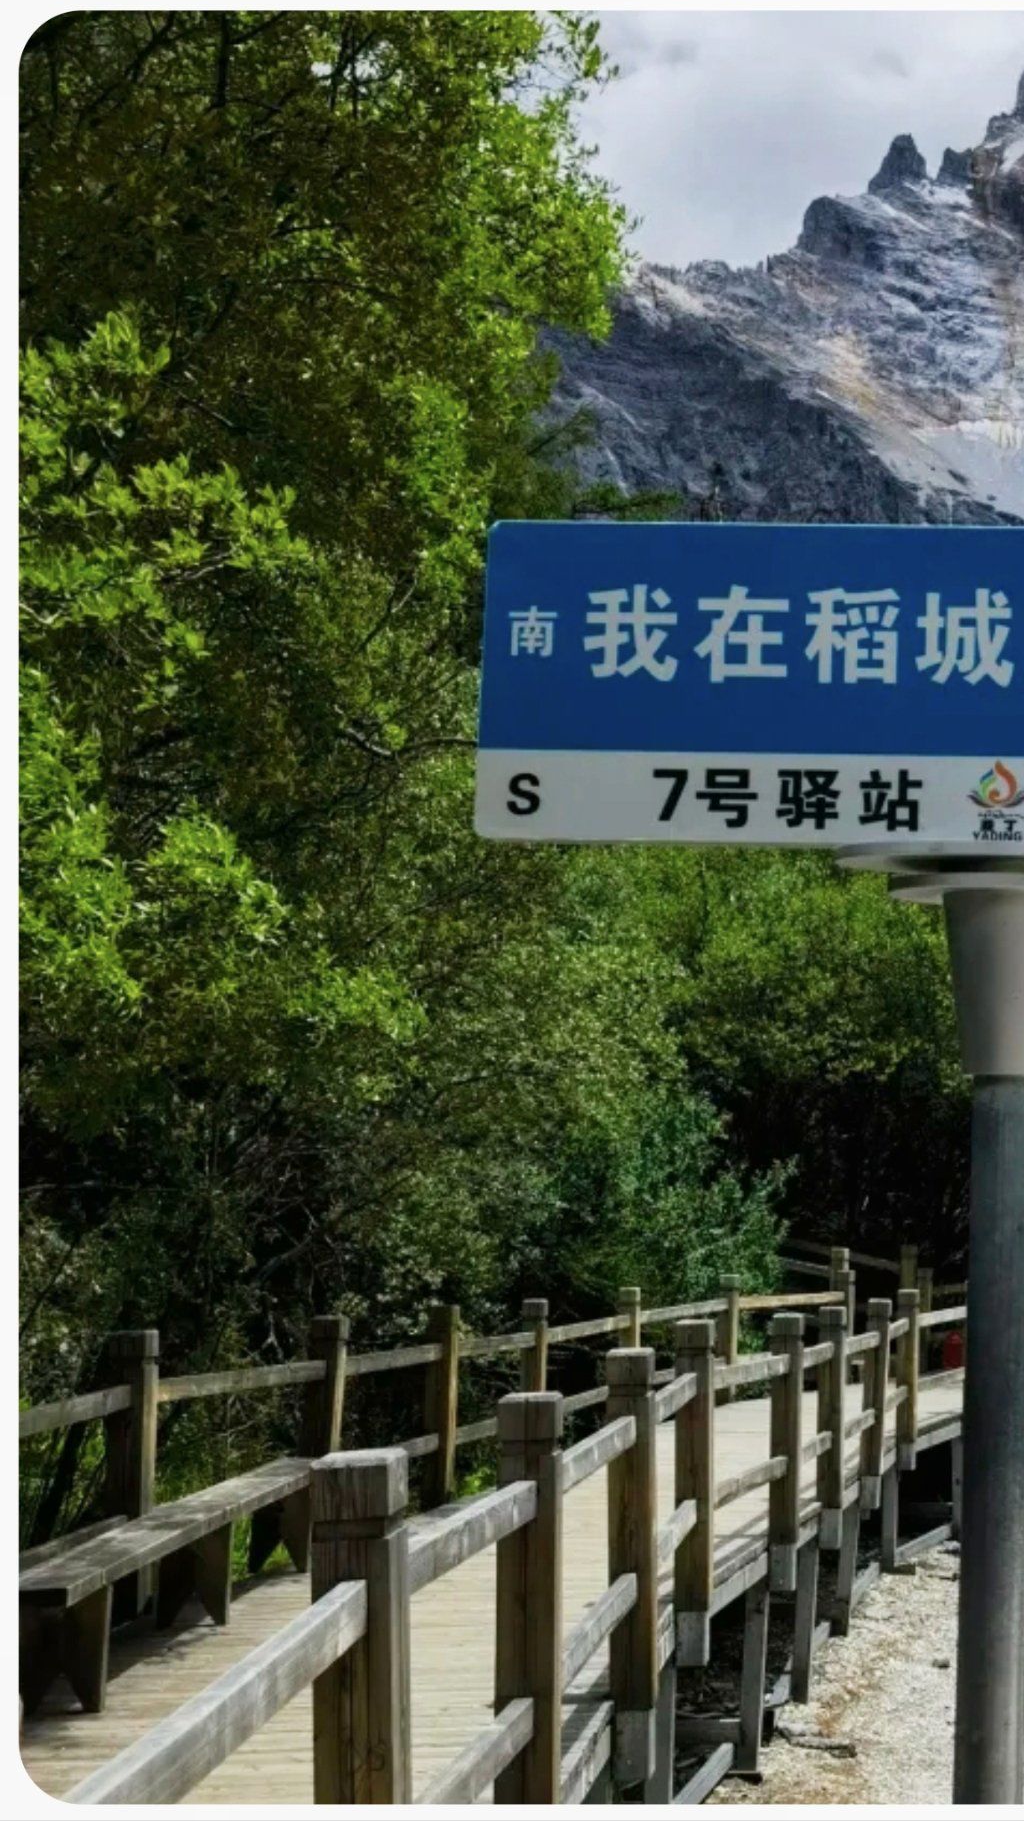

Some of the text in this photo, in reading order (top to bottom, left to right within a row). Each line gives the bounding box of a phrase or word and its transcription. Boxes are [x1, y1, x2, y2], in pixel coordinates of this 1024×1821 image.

[508, 605, 559, 657] 南
[506, 773, 541, 815] S
[652, 768, 923, 831] 7号驿站
[972, 831, 1023, 841] YADING
